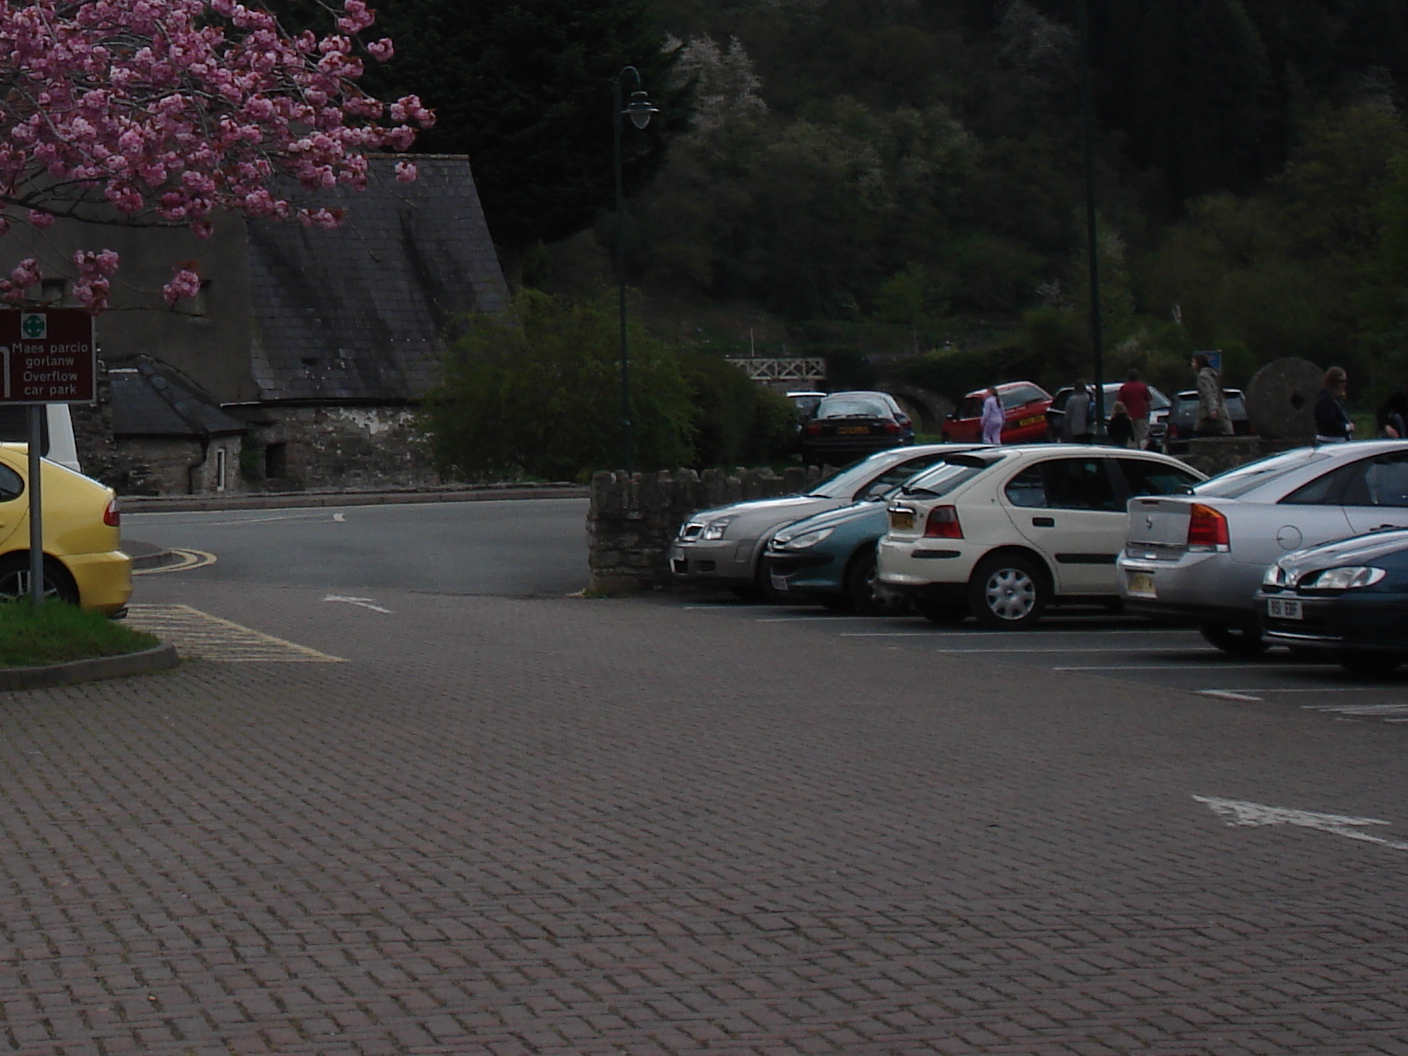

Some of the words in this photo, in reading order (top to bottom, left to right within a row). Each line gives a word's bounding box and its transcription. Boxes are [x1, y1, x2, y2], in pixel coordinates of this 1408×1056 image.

[12, 342, 45, 353] Maes
[50, 341, 88, 354] parcio
[26, 356, 74, 368] gorlanw
[23, 371, 77, 382] Overflow
[24, 385, 44, 395] car
[50, 384, 77, 396] park
